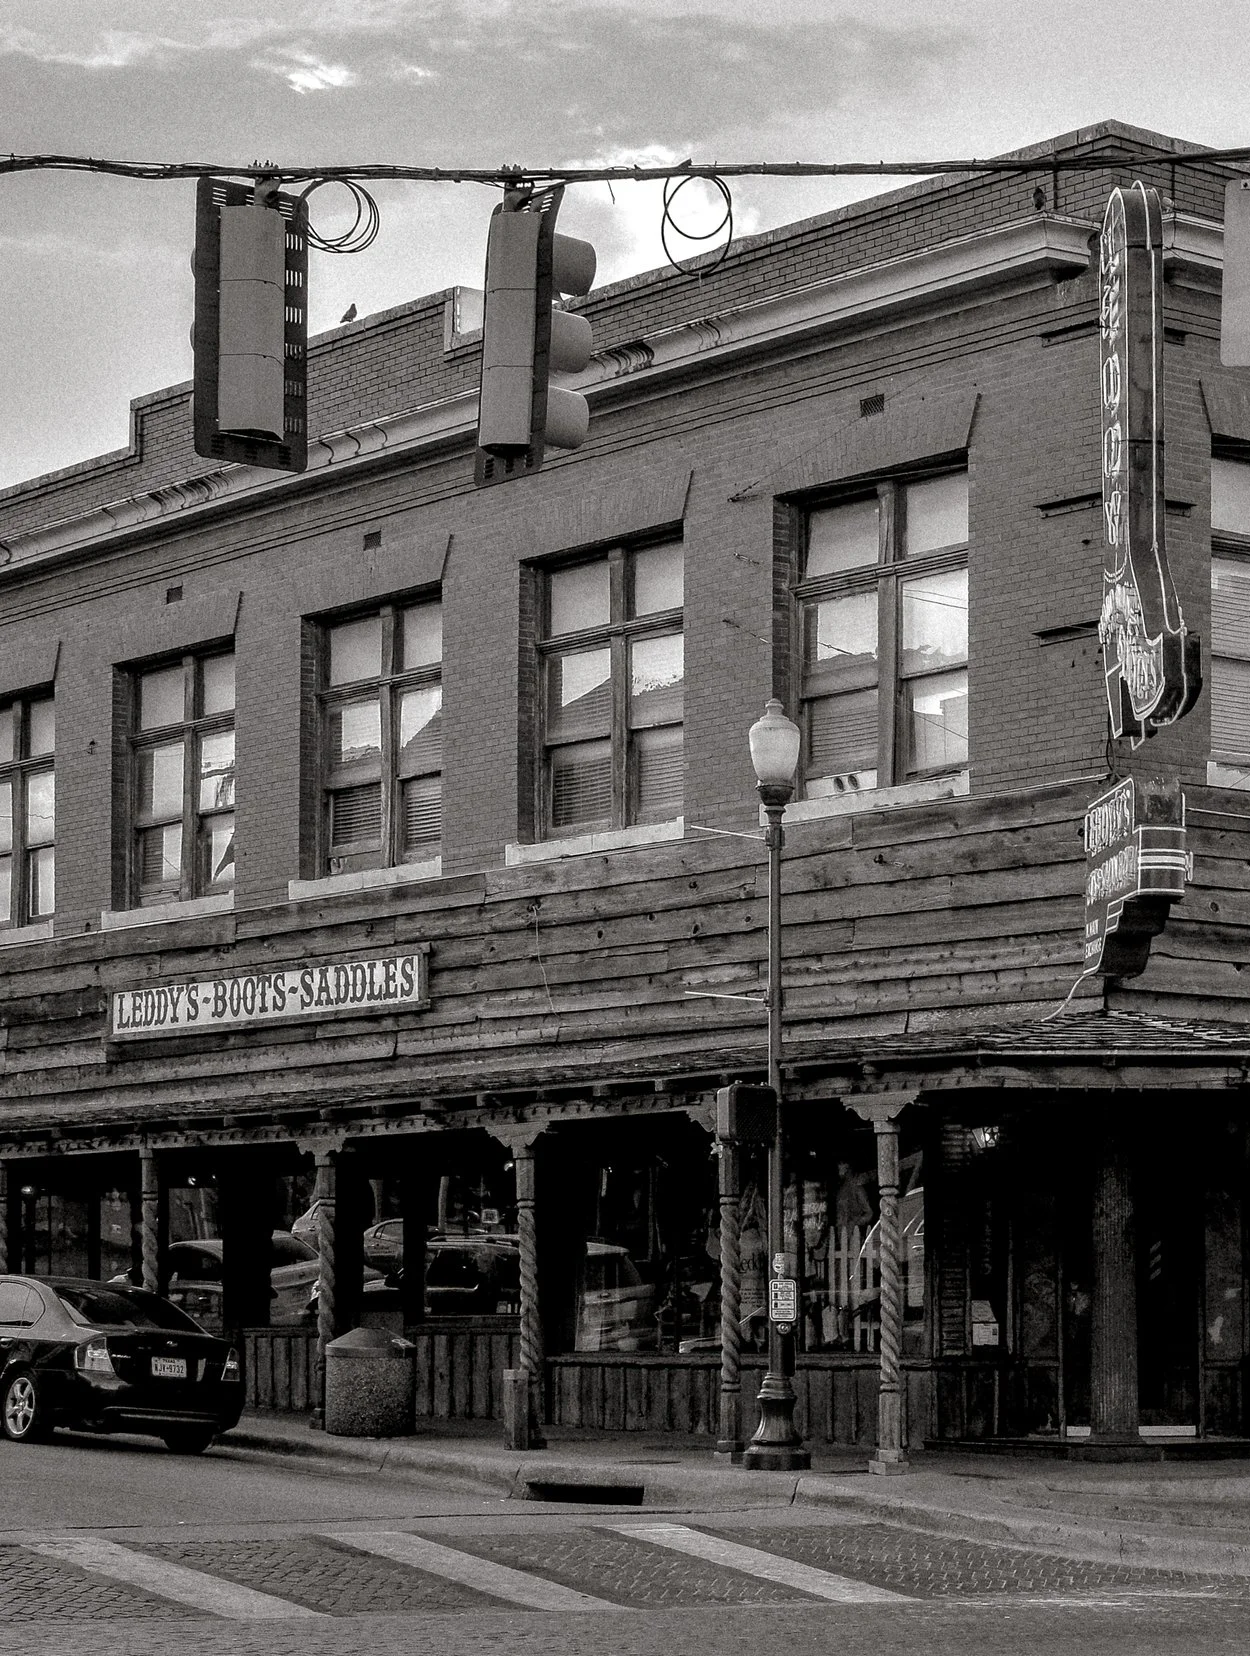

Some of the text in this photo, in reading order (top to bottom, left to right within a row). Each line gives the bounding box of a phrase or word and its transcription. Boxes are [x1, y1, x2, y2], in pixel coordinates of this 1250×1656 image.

[117, 956, 416, 1030] LEDDY'S BOOTS SADDLES
